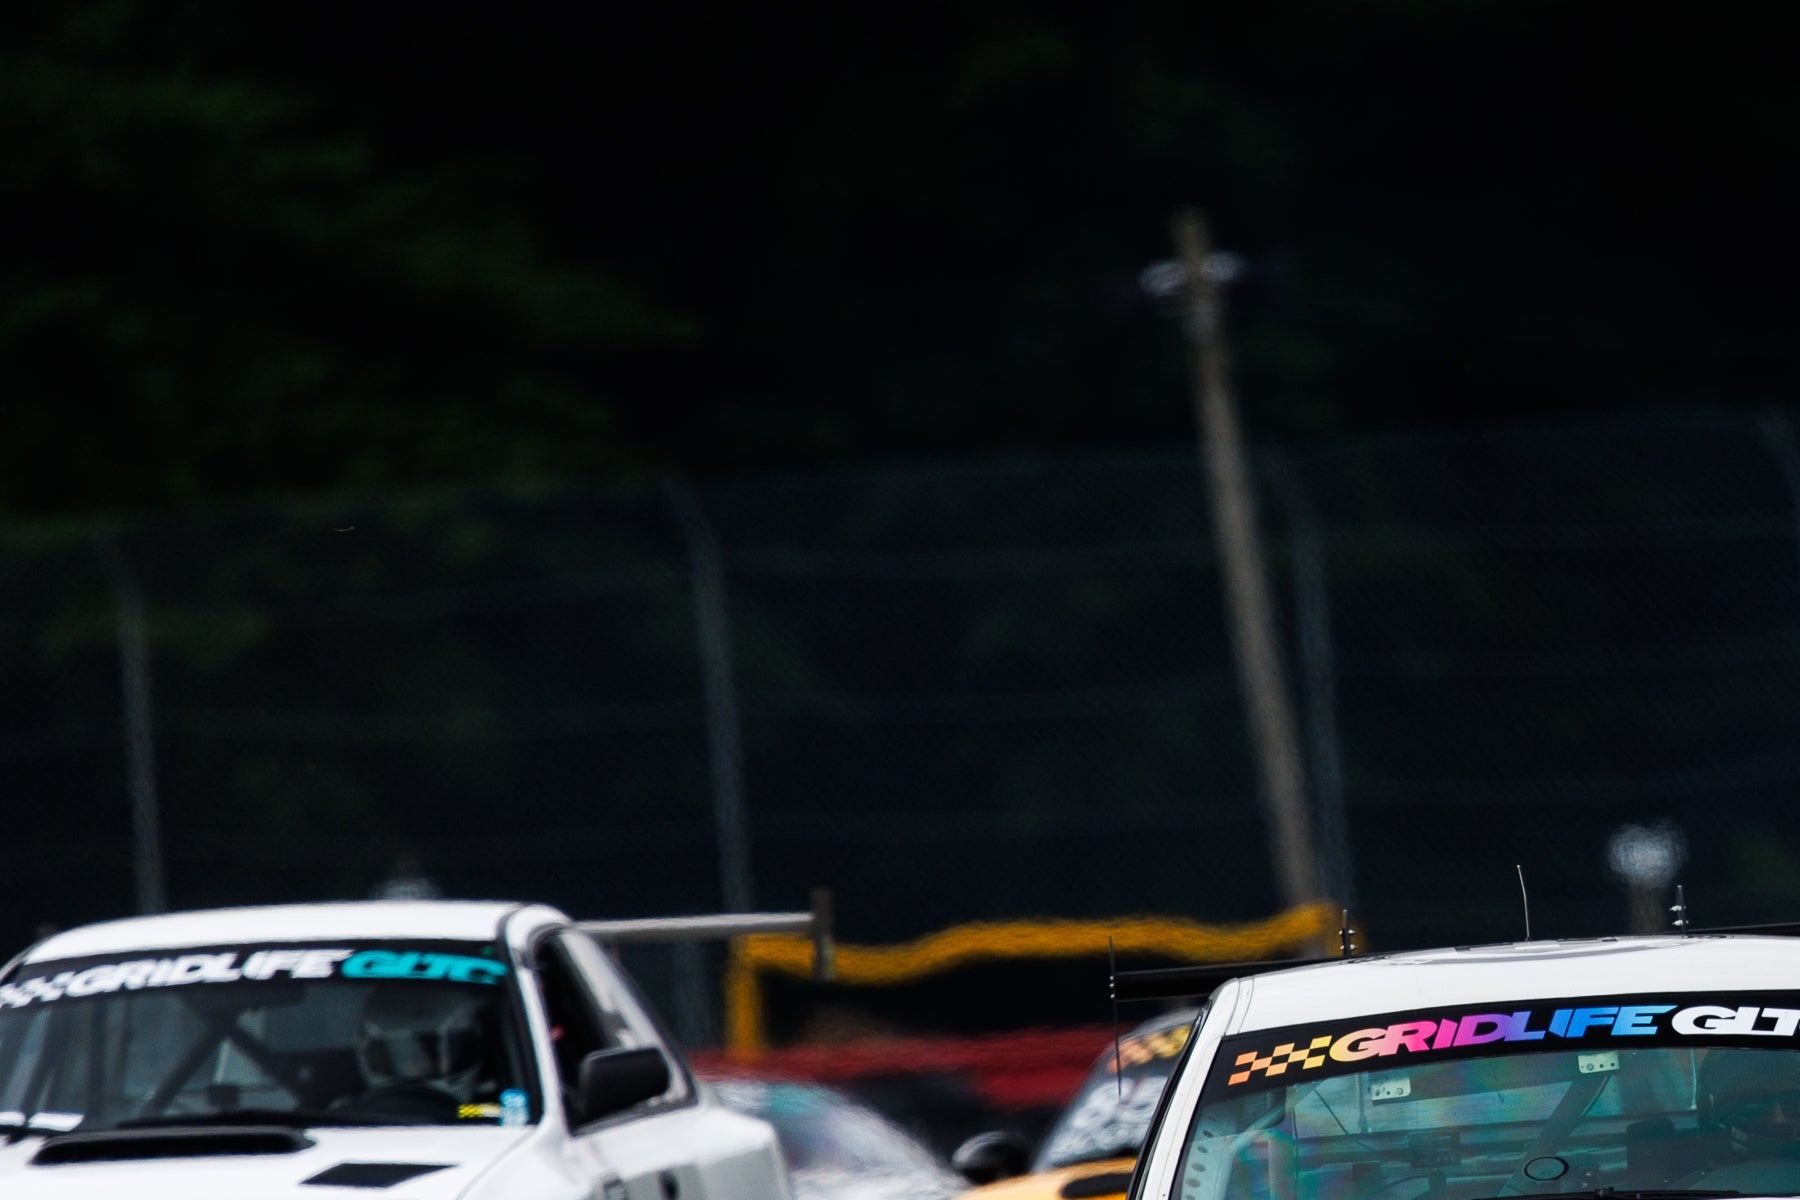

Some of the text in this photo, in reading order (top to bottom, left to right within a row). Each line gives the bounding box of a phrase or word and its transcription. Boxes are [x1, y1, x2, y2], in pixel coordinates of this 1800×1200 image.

[65, 949, 507, 998] GRIDLIFE GLTC
[1328, 1004, 1678, 1062] GRIDLIFE
